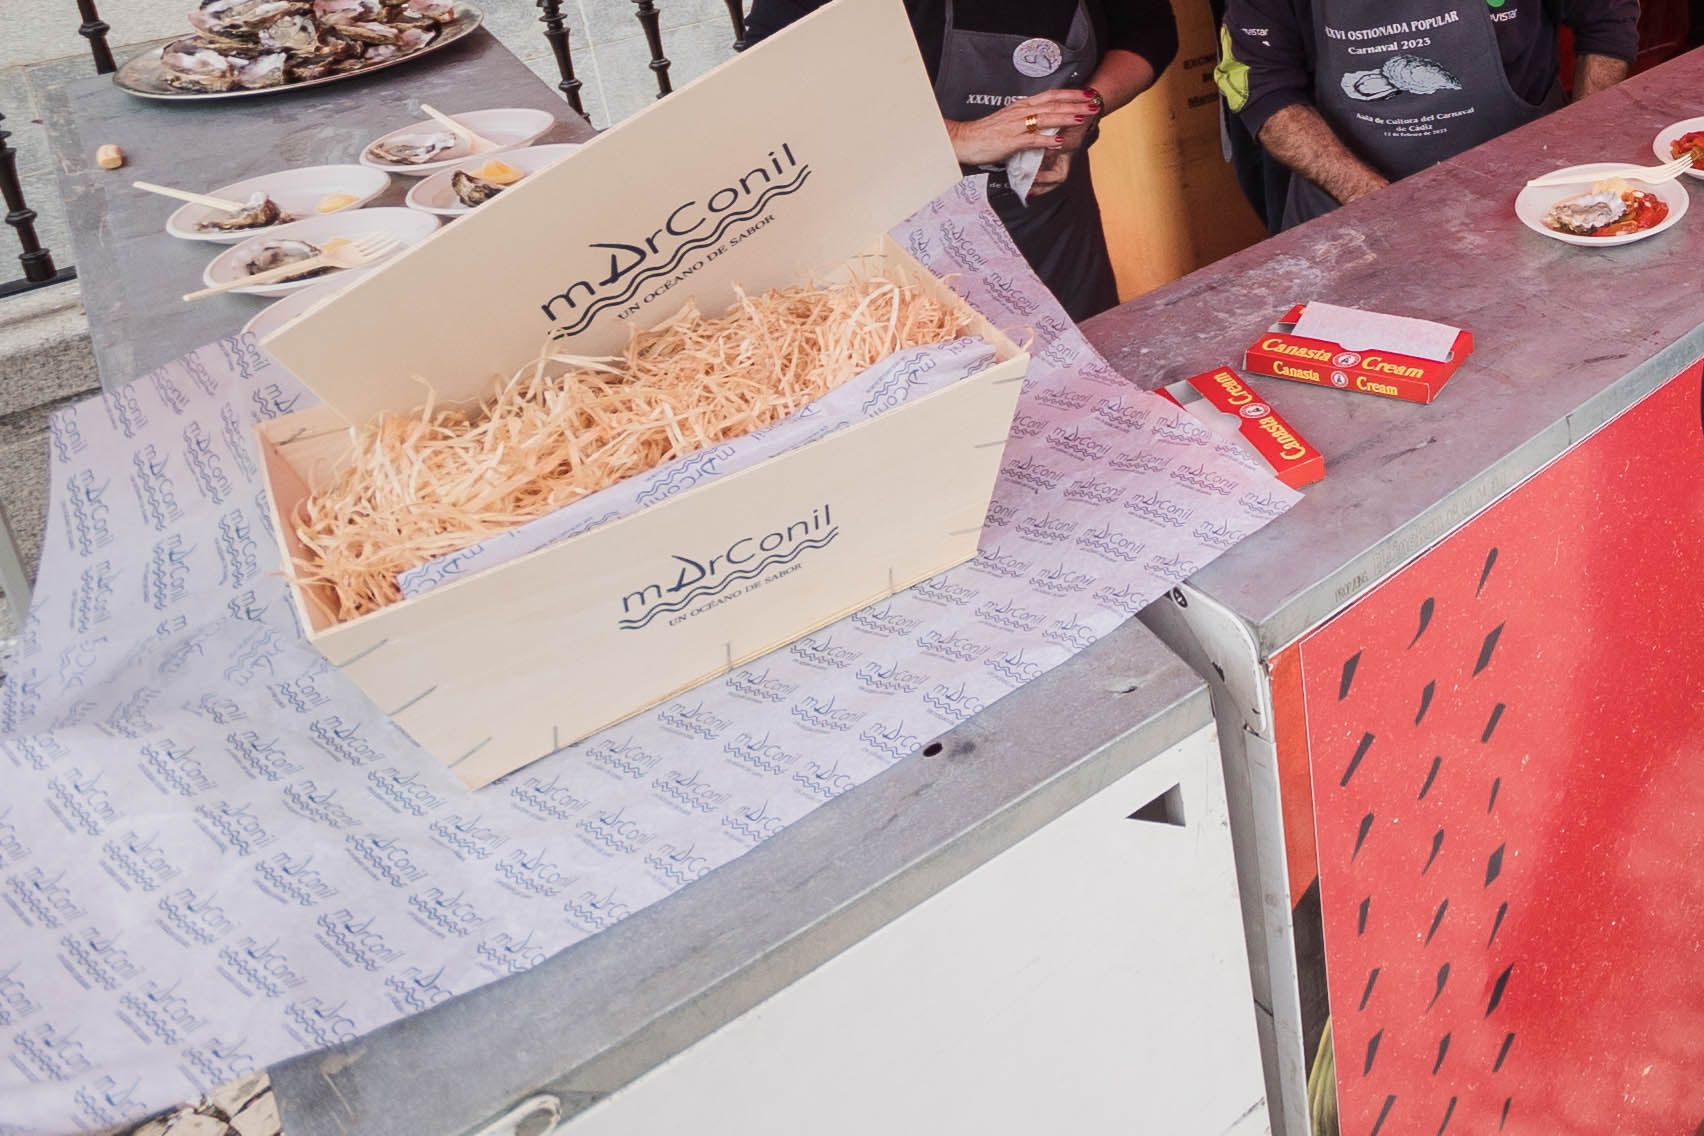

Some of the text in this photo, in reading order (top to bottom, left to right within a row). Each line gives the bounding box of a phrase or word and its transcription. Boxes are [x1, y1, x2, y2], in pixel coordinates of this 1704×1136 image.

[1348, 22, 1409, 40] OSTIONADA
[1411, 10, 1459, 32] POPULAR
[1348, 37, 1431, 55] Carnaval 2023
[1421, 114, 1435, 122] del
[1437, 107, 1475, 120] Carnaval
[617, 303, 640, 321] UN
[706, 245, 729, 262] DE
[730, 214, 776, 246] SABOR
[1261, 338, 1425, 379] Canasta Cream
[1213, 371, 1253, 406] Cream
[1273, 361, 1398, 396] Canasta Cream
[1258, 415, 1307, 461] Canasta
[669, 614, 687, 626] UN
[745, 580, 763, 593] DE
[764, 563, 802, 584] SABOR
